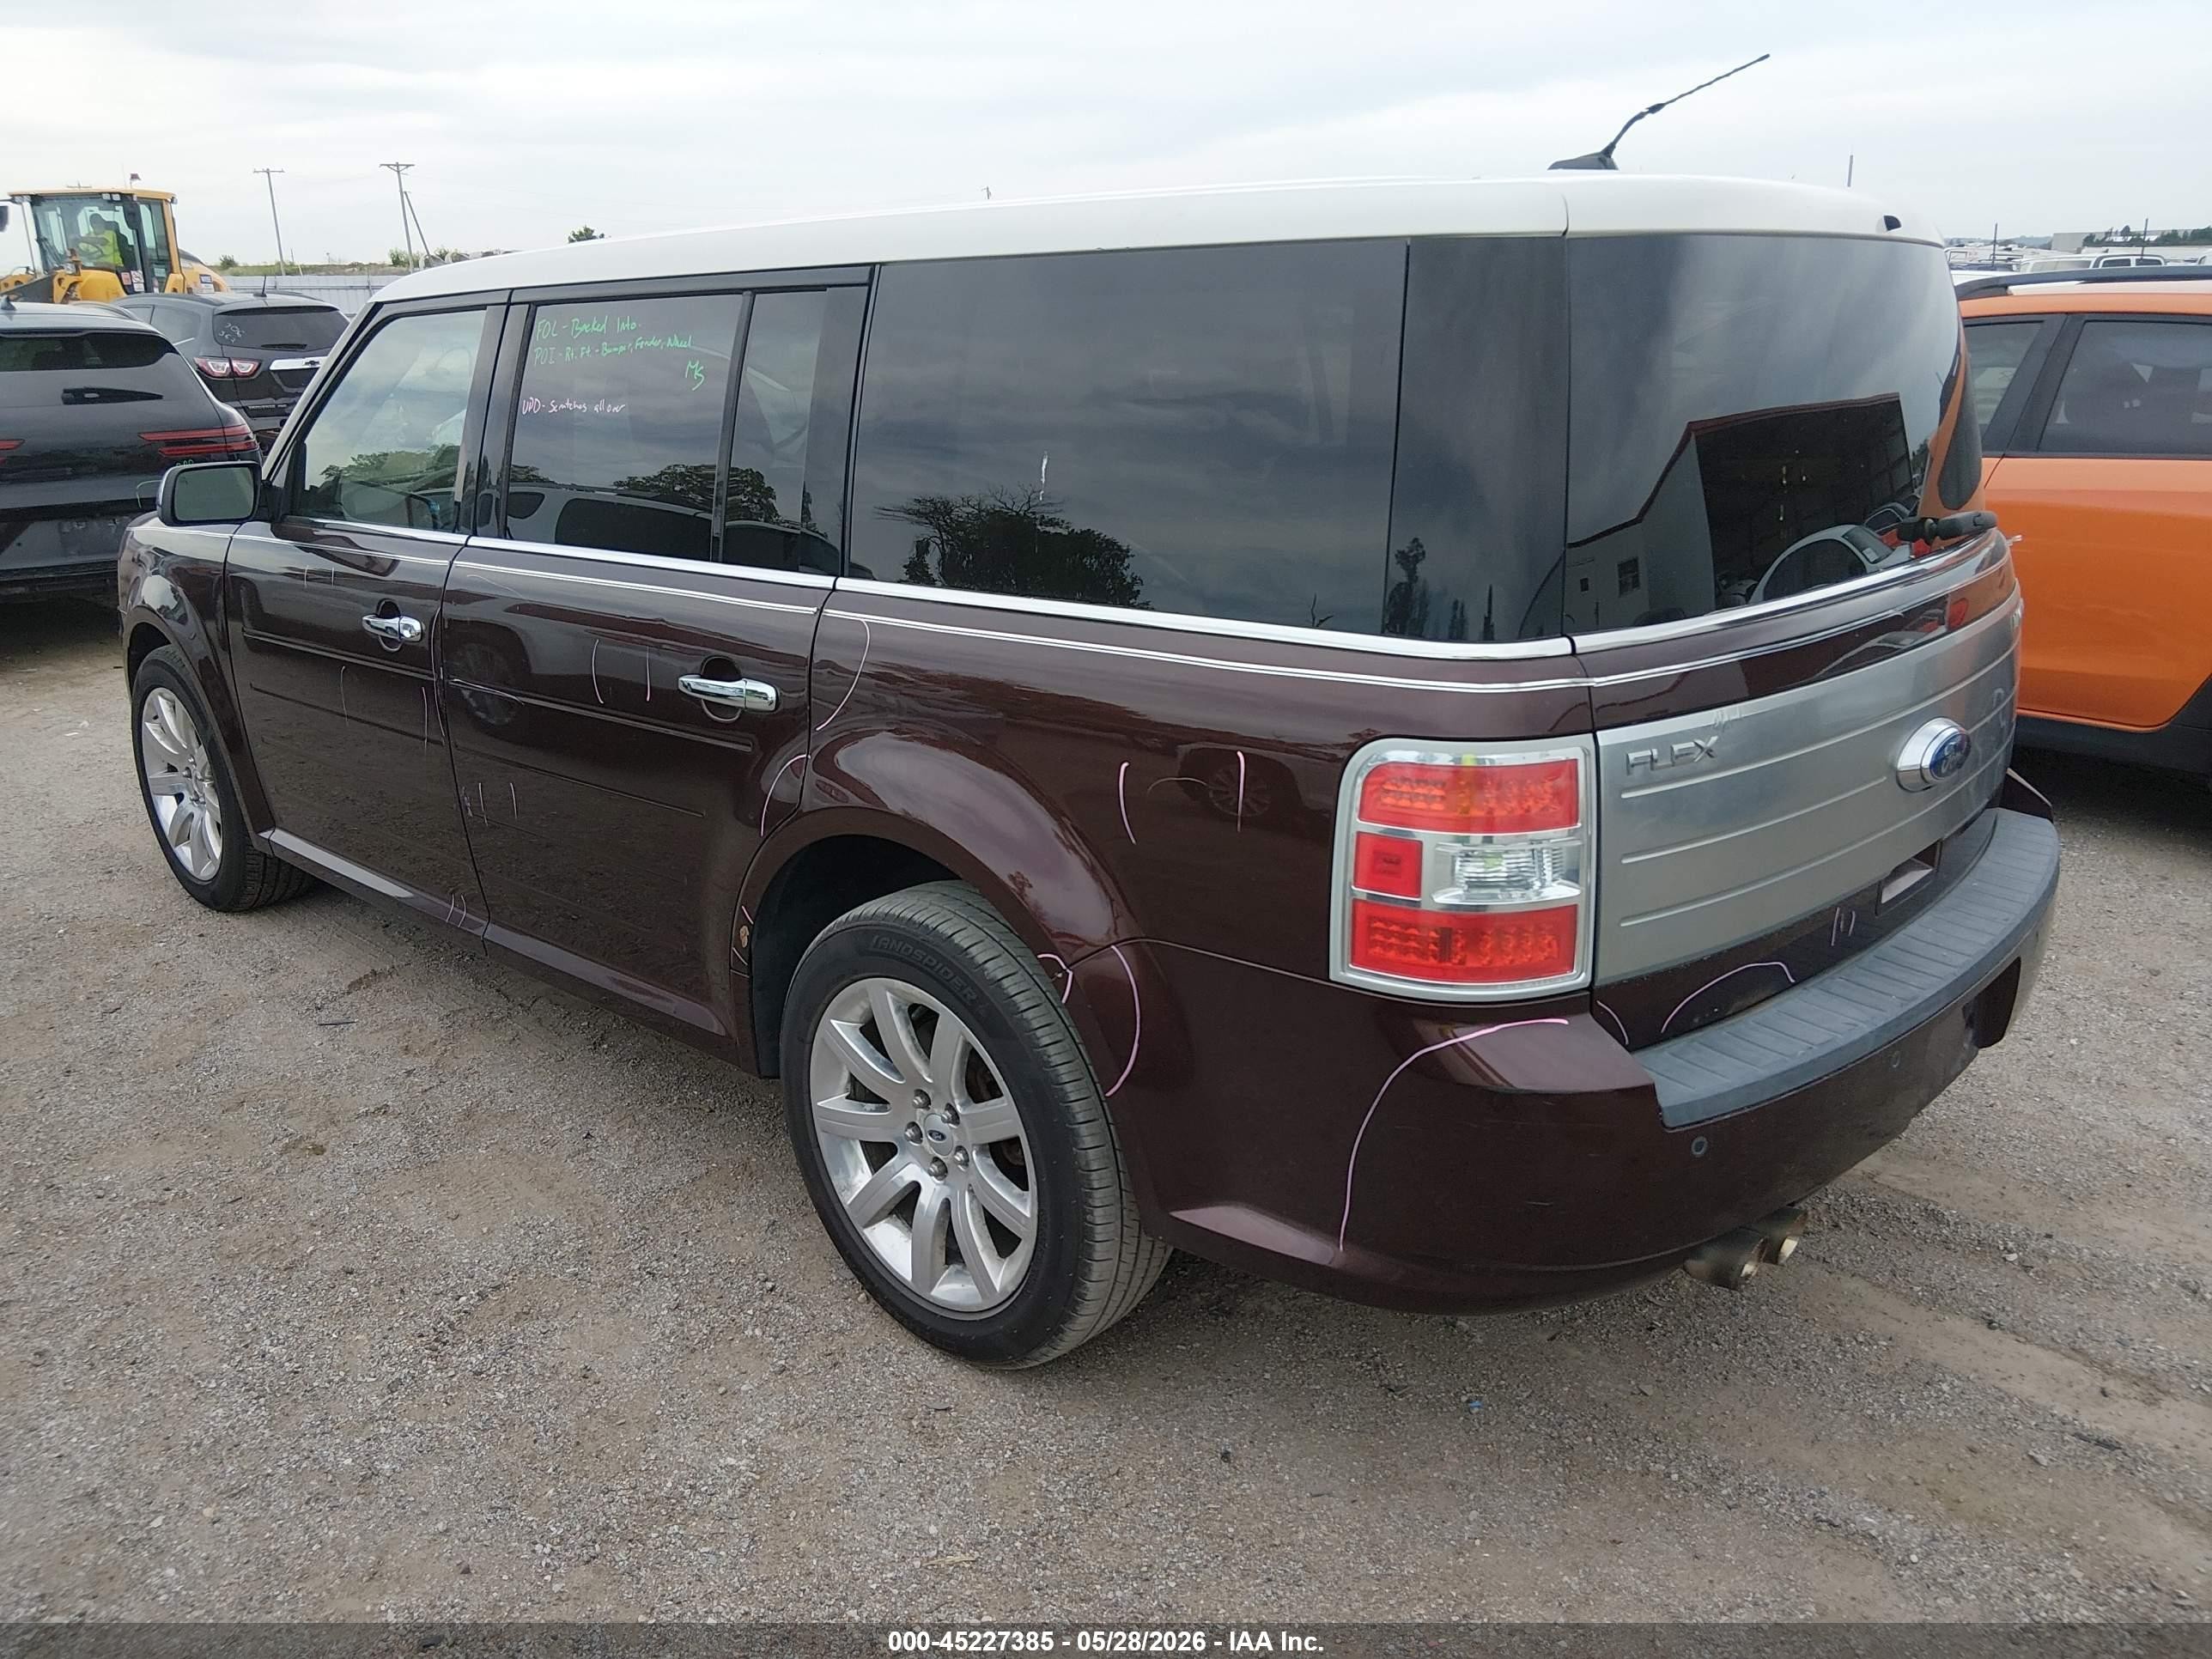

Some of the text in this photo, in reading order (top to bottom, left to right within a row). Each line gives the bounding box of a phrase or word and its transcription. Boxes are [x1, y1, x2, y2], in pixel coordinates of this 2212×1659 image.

[548, 398, 588, 413] Scratches
[593, 398, 605, 413] all
[606, 404, 626, 413] over
[1626, 735, 1719, 776] FLEX
